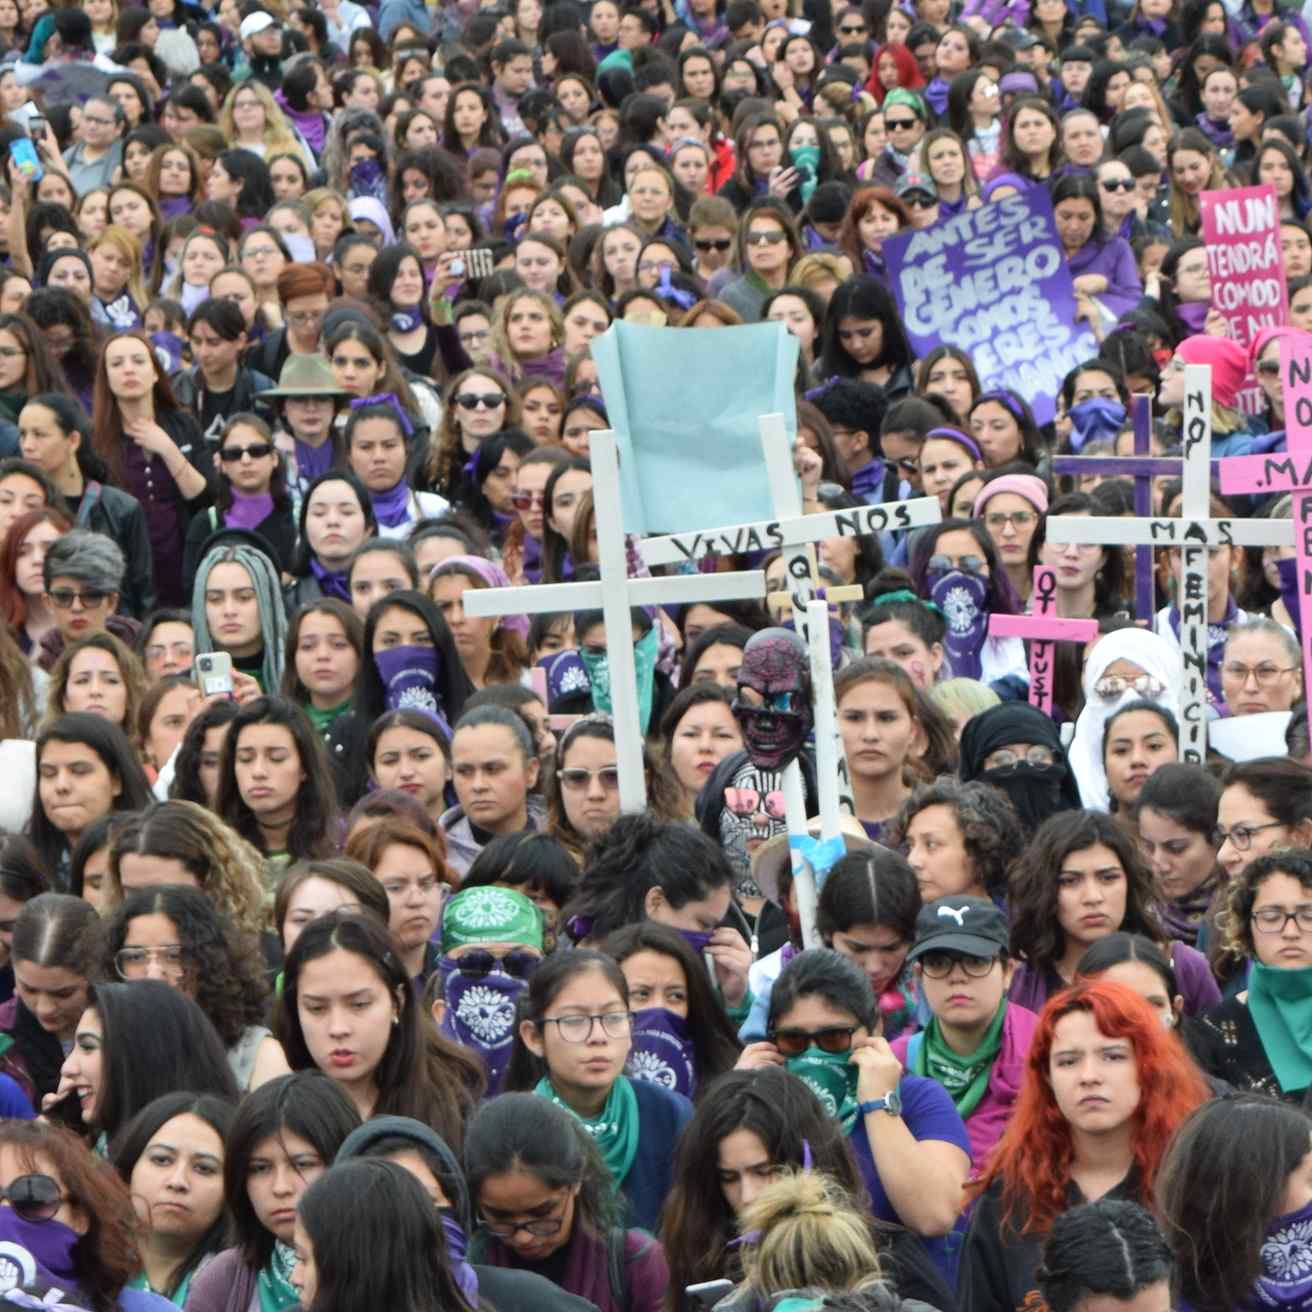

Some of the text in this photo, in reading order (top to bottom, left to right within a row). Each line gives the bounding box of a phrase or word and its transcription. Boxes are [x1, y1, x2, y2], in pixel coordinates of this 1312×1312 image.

[903, 196, 1030, 263] ANTES
[963, 216, 1053, 267] SER
[671, 504, 912, 559] VIVAS NOS
[1151, 520, 1234, 546] MAS
